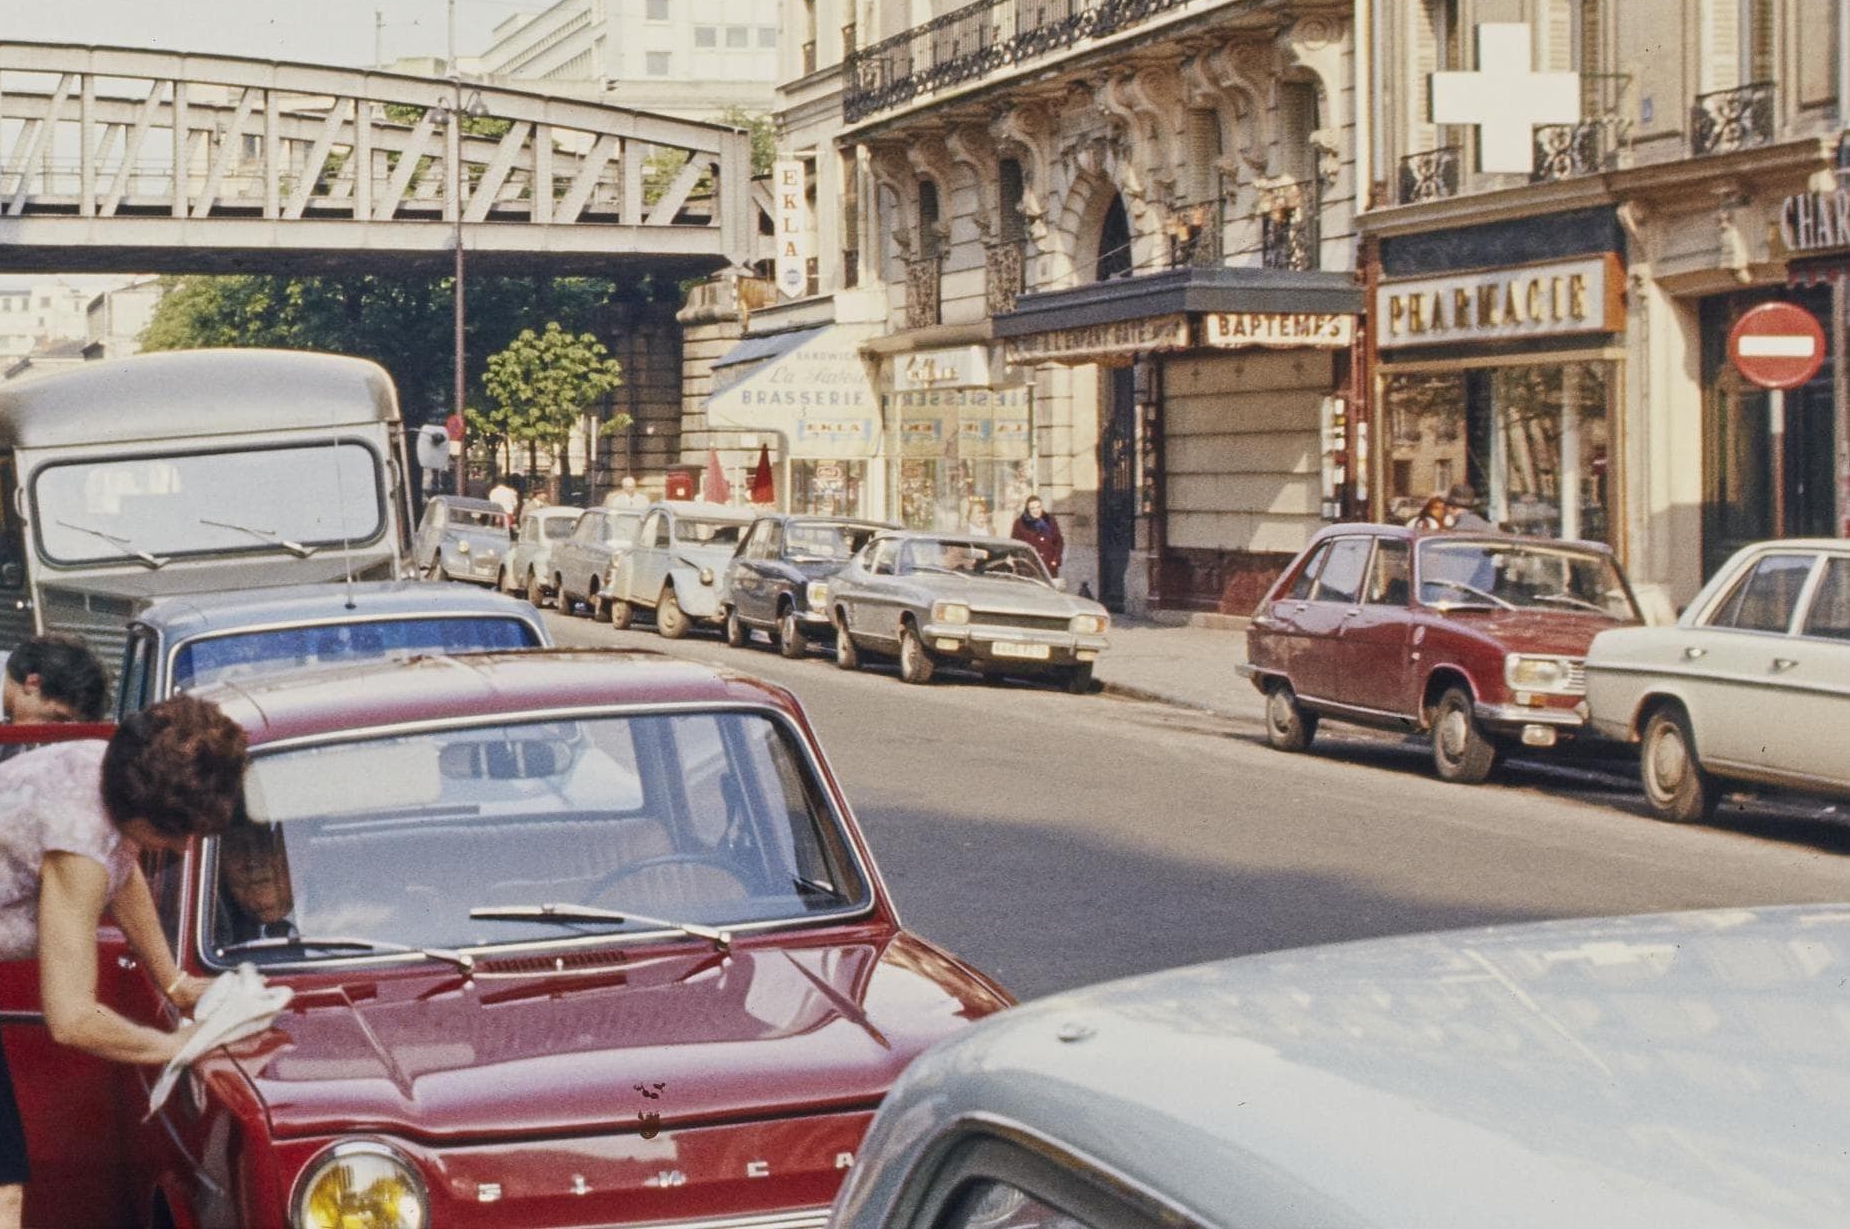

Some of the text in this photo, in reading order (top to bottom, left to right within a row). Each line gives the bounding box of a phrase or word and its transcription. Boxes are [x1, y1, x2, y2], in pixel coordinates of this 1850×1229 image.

[782, 169, 799, 258] EKLA
[1389, 274, 1585, 336] PHARMACIE
[741, 390, 864, 406] BRASSERIE
[476, 1151, 855, 1204] SIMCA
